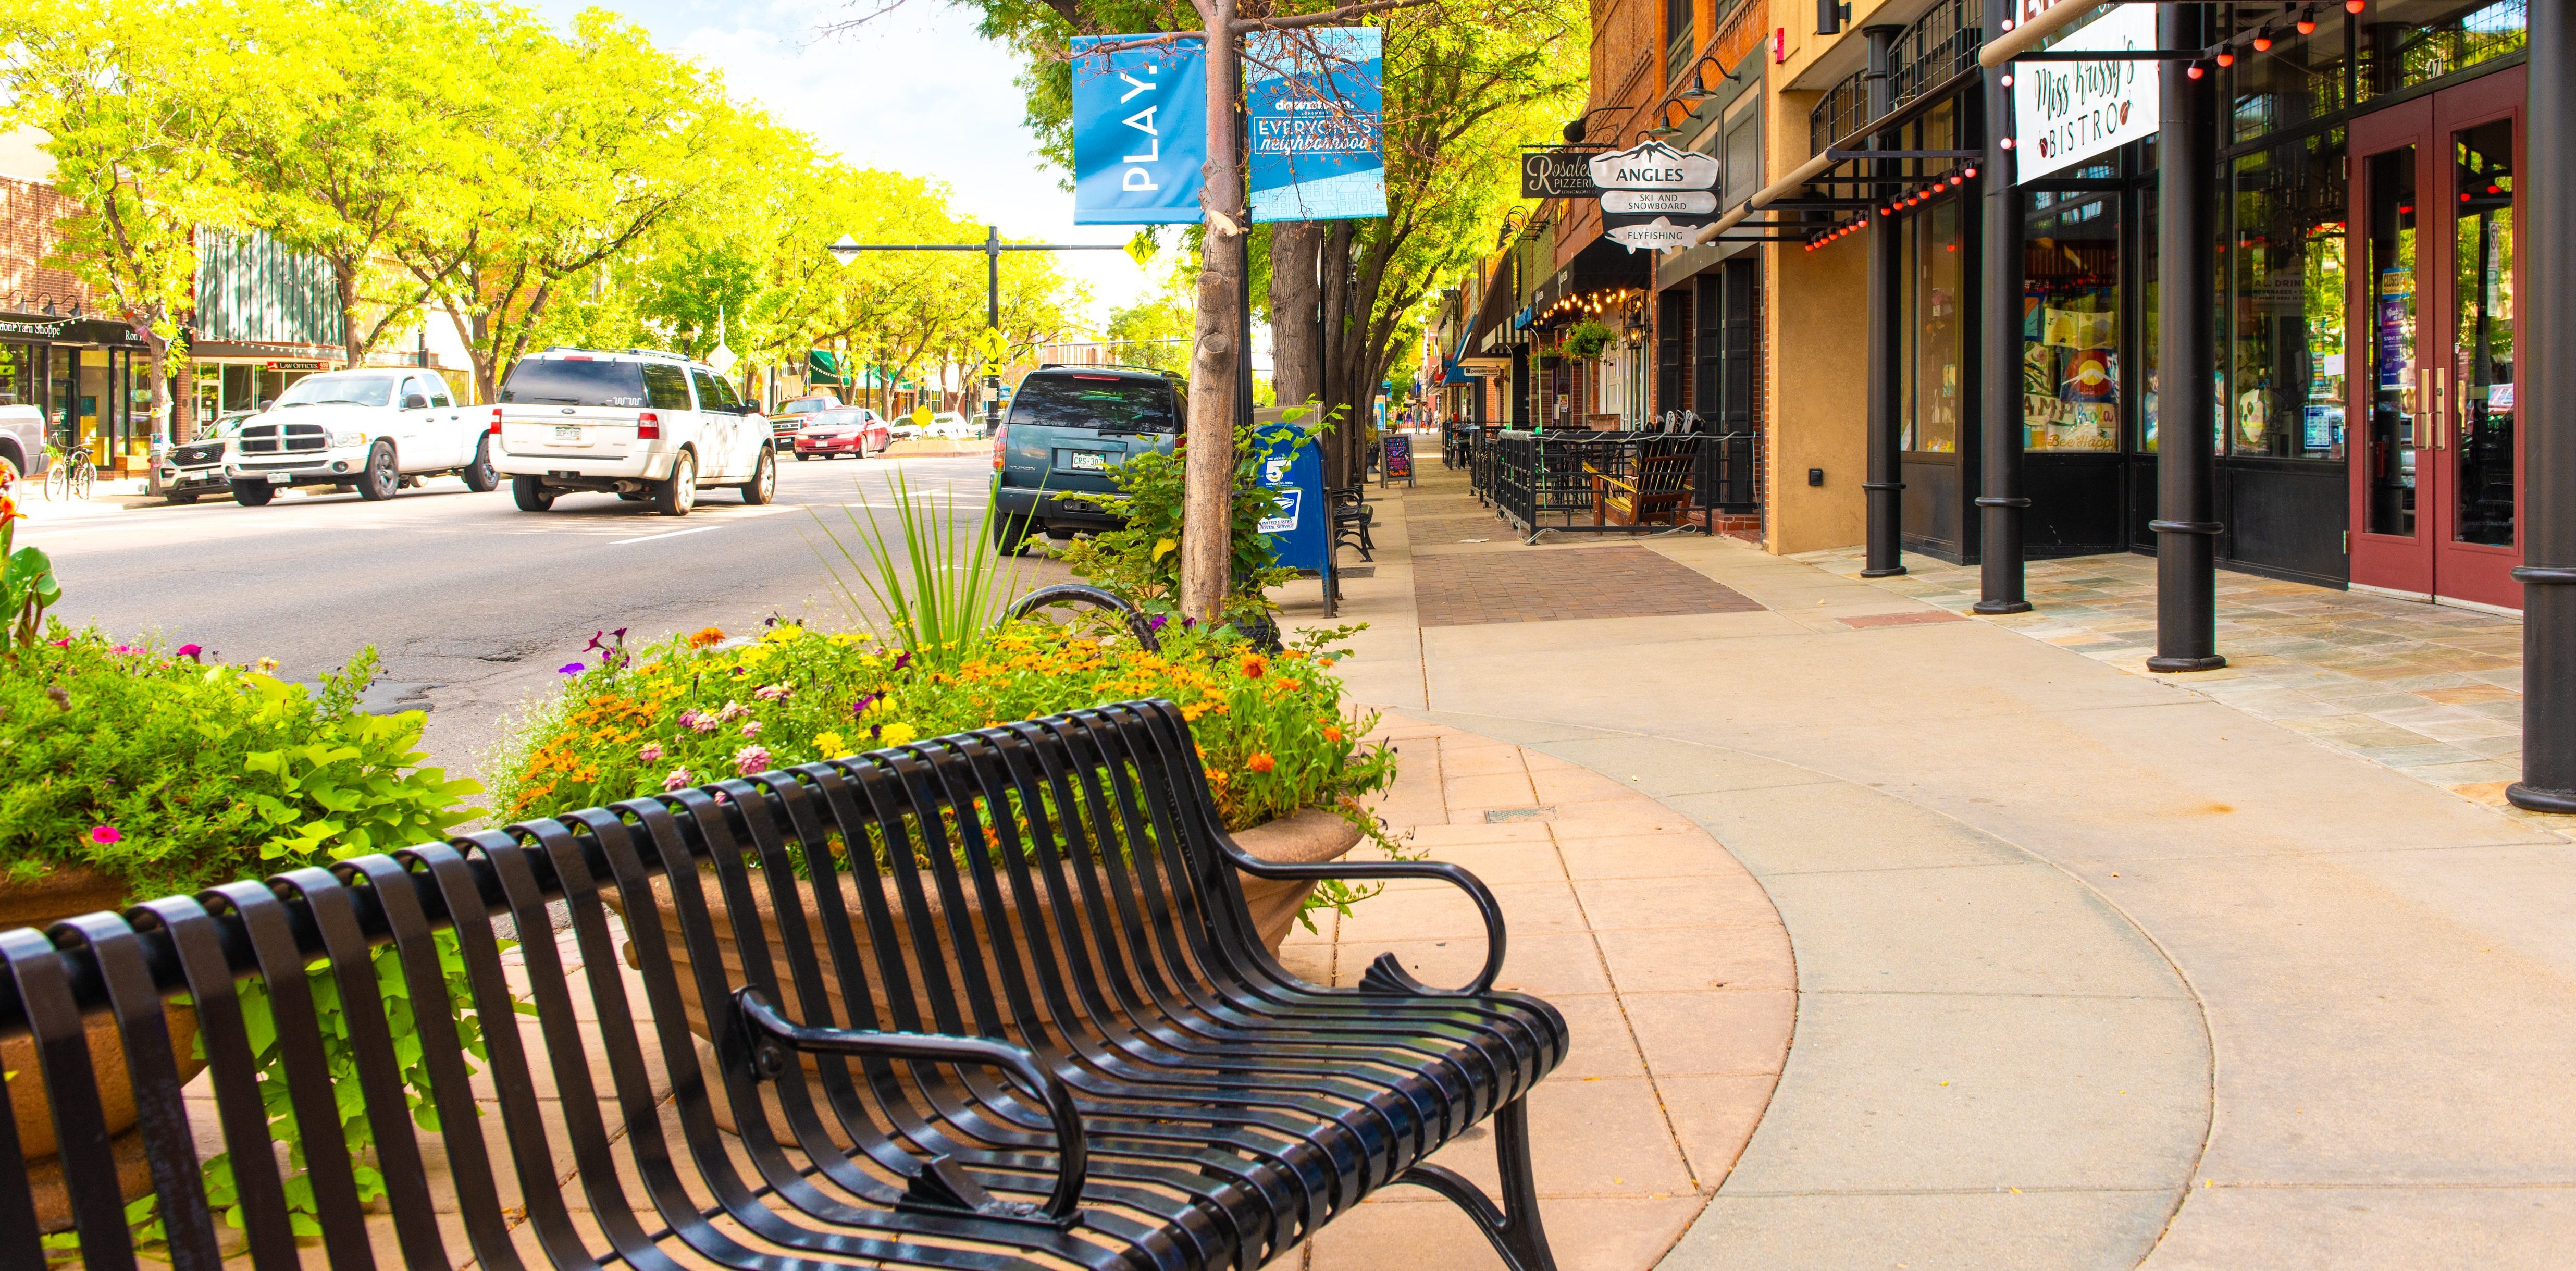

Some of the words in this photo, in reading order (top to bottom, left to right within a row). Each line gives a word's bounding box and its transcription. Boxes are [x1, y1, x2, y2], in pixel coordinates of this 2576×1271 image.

[2428, 58, 2443, 78] 471
[2035, 68, 2070, 121] Miss
[1120, 65, 1158, 192] PLAY.
[1259, 120, 1371, 135] EVERYONE'S
[2050, 102, 2117, 158] BISTRO
[1260, 135, 1371, 155] neighborhood
[1616, 168, 1683, 182] ANGLES
[2384, 274, 2400, 287] CLOSED
[35, 324, 61, 338] Shoppe
[125, 330, 138, 341] Ron
[2048, 434, 2074, 447] Bee
[2076, 434, 2117, 451] Happy
[1266, 460, 1292, 482] 5
